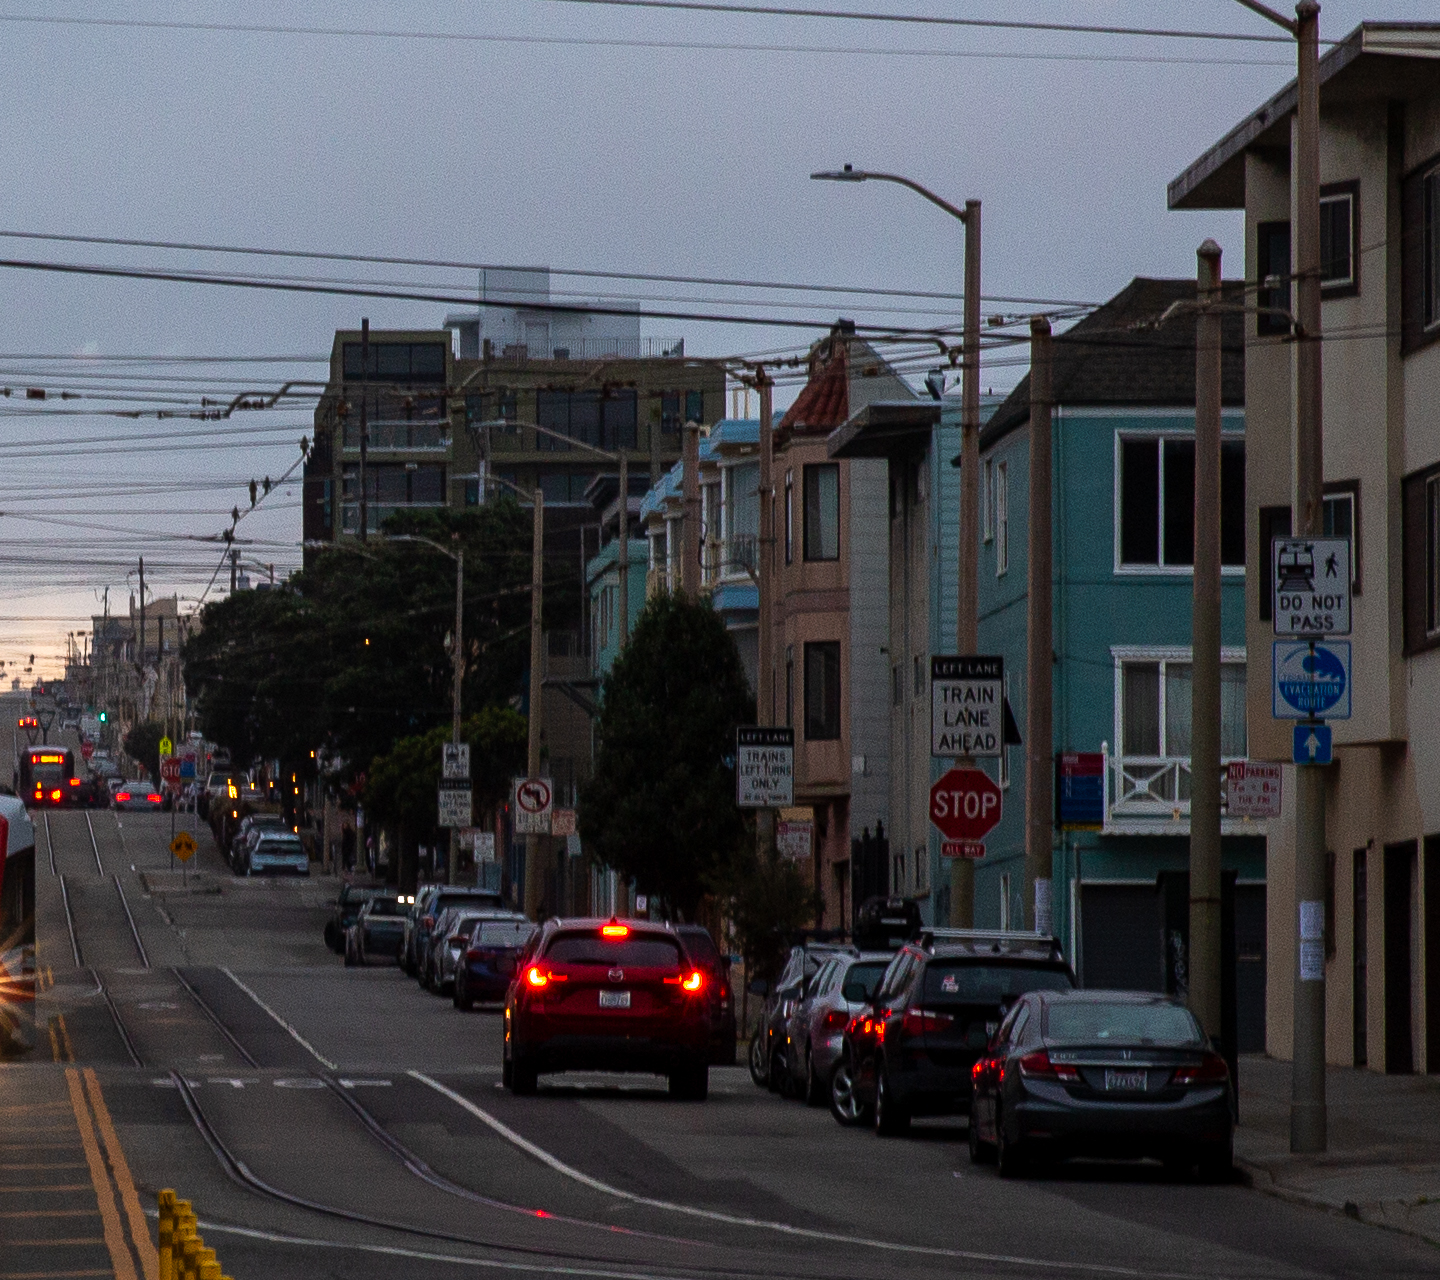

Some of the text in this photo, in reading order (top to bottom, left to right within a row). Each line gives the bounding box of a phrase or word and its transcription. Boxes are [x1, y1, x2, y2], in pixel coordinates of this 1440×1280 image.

[1280, 595, 1343, 611] DO NOT
[1291, 615, 1334, 631] PASS
[935, 662, 999, 675] LEFT LANE
[942, 686, 994, 703] TRAIN
[1284, 683, 1340, 696] EVACUATION
[1298, 697, 1326, 709] ROUTE
[944, 709, 990, 727] LANE
[939, 733, 996, 751] AHEAD
[747, 750, 785, 763] TRAINS
[1229, 764, 1280, 779] NO PARKING
[751, 779, 779, 791] ONLY
[934, 790, 998, 819] STOP
[945, 843, 982, 855] ALL WAY
